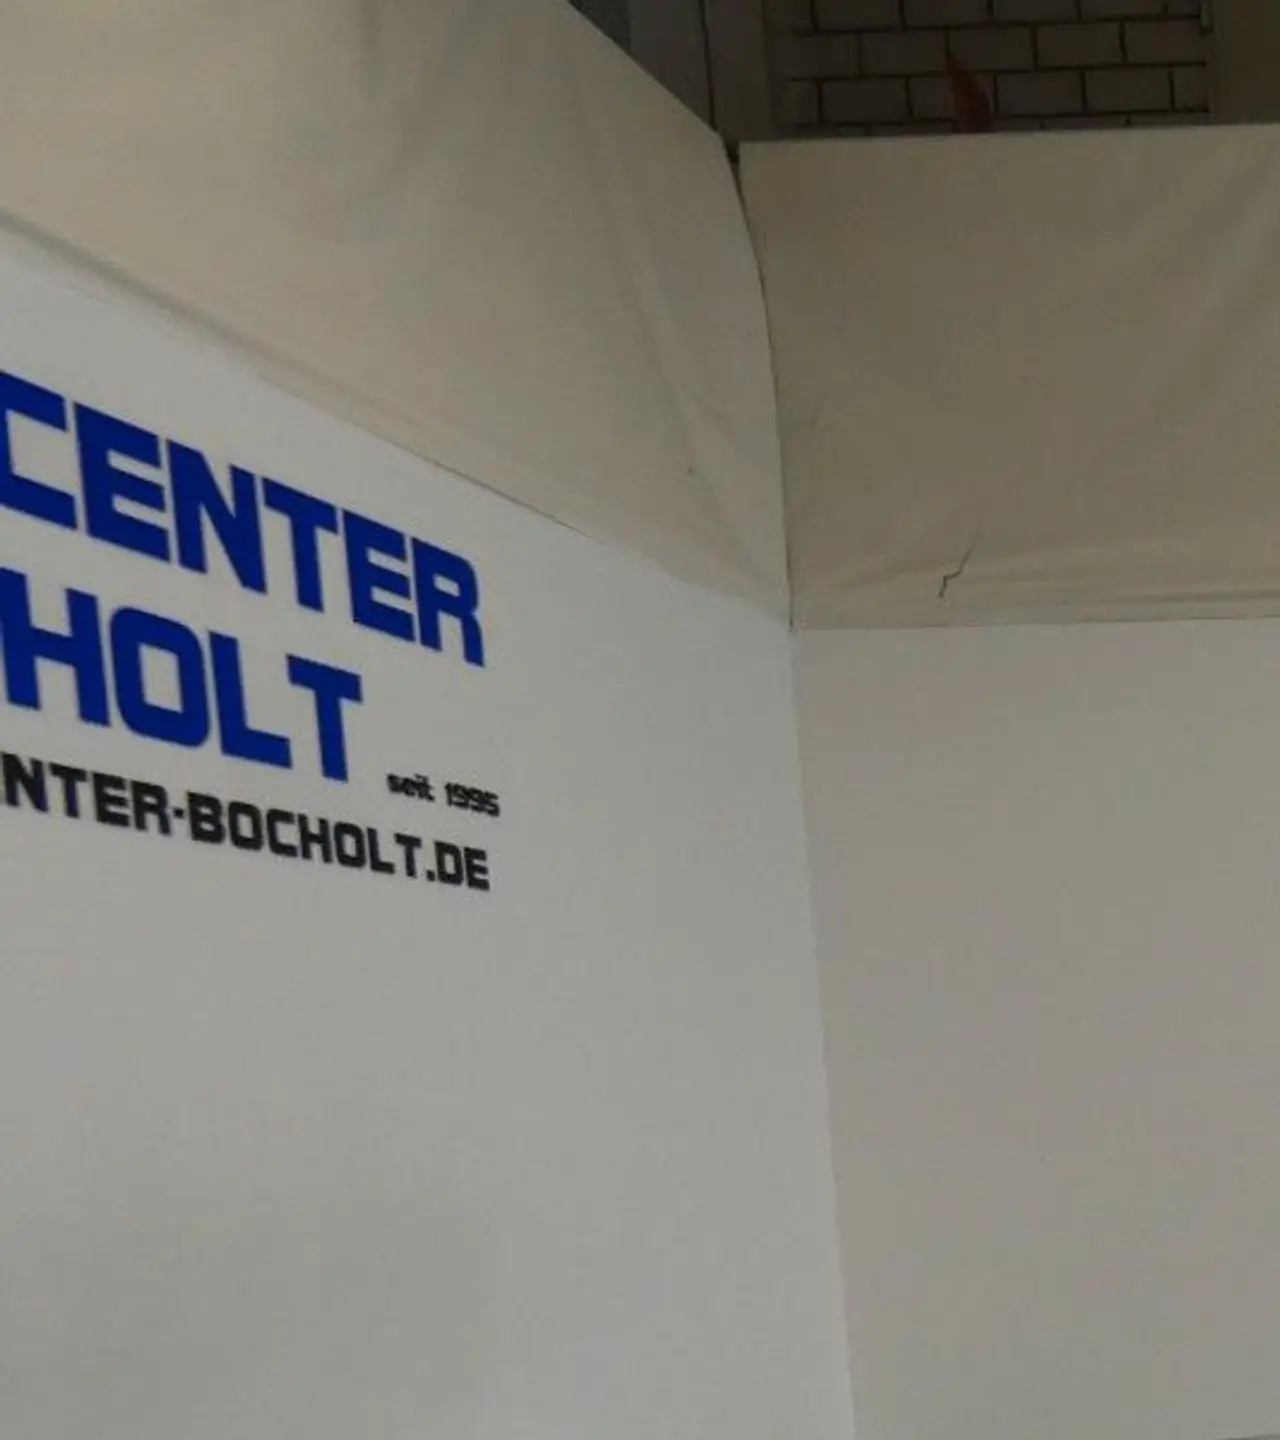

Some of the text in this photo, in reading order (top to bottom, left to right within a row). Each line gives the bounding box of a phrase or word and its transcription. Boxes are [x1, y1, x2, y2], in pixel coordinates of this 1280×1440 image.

[0, 370, 485, 666] CENTER
[0, 566, 362, 782] HOLT
[444, 782, 500, 818] 1995
